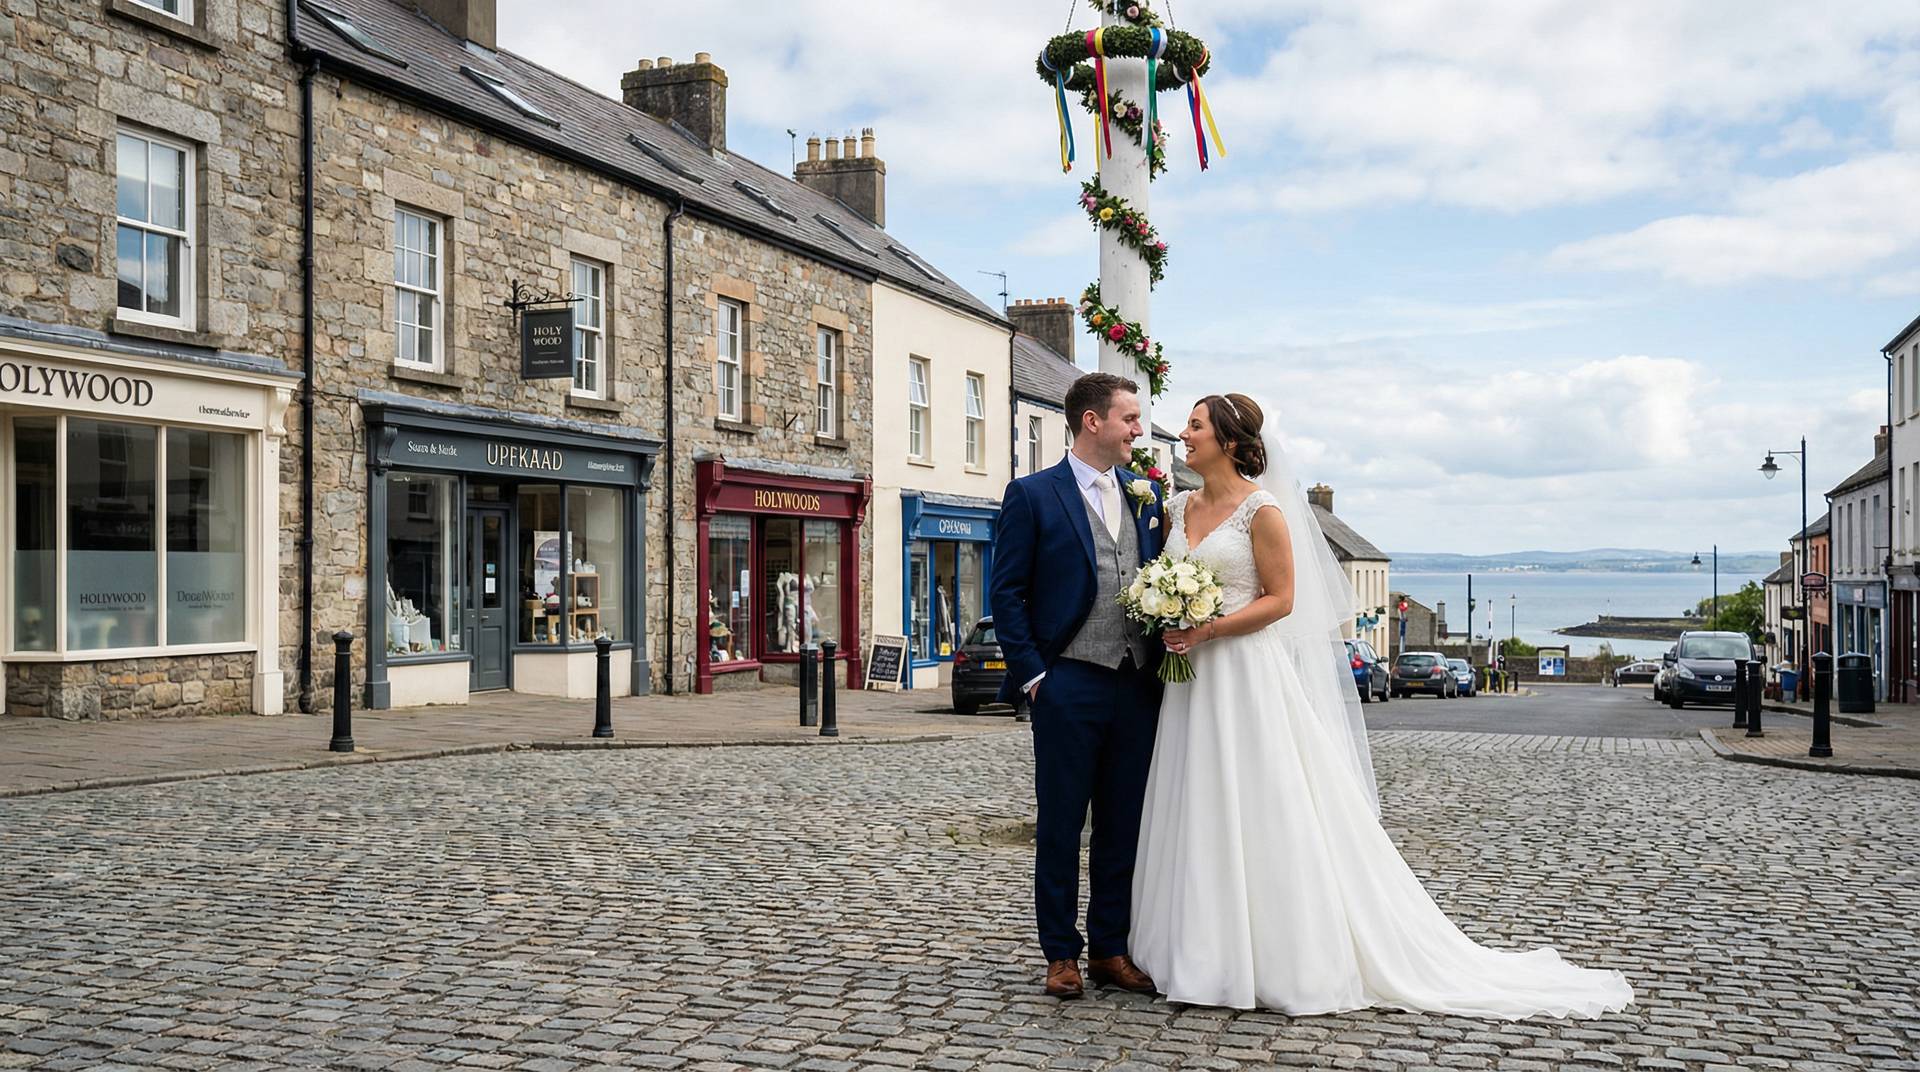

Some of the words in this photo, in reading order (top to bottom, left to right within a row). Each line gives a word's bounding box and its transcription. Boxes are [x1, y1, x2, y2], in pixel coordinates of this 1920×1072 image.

[533, 326, 562, 336] HOLY
[532, 336, 562, 346] WOOD
[754, 489, 820, 511] HOLYWOODS
